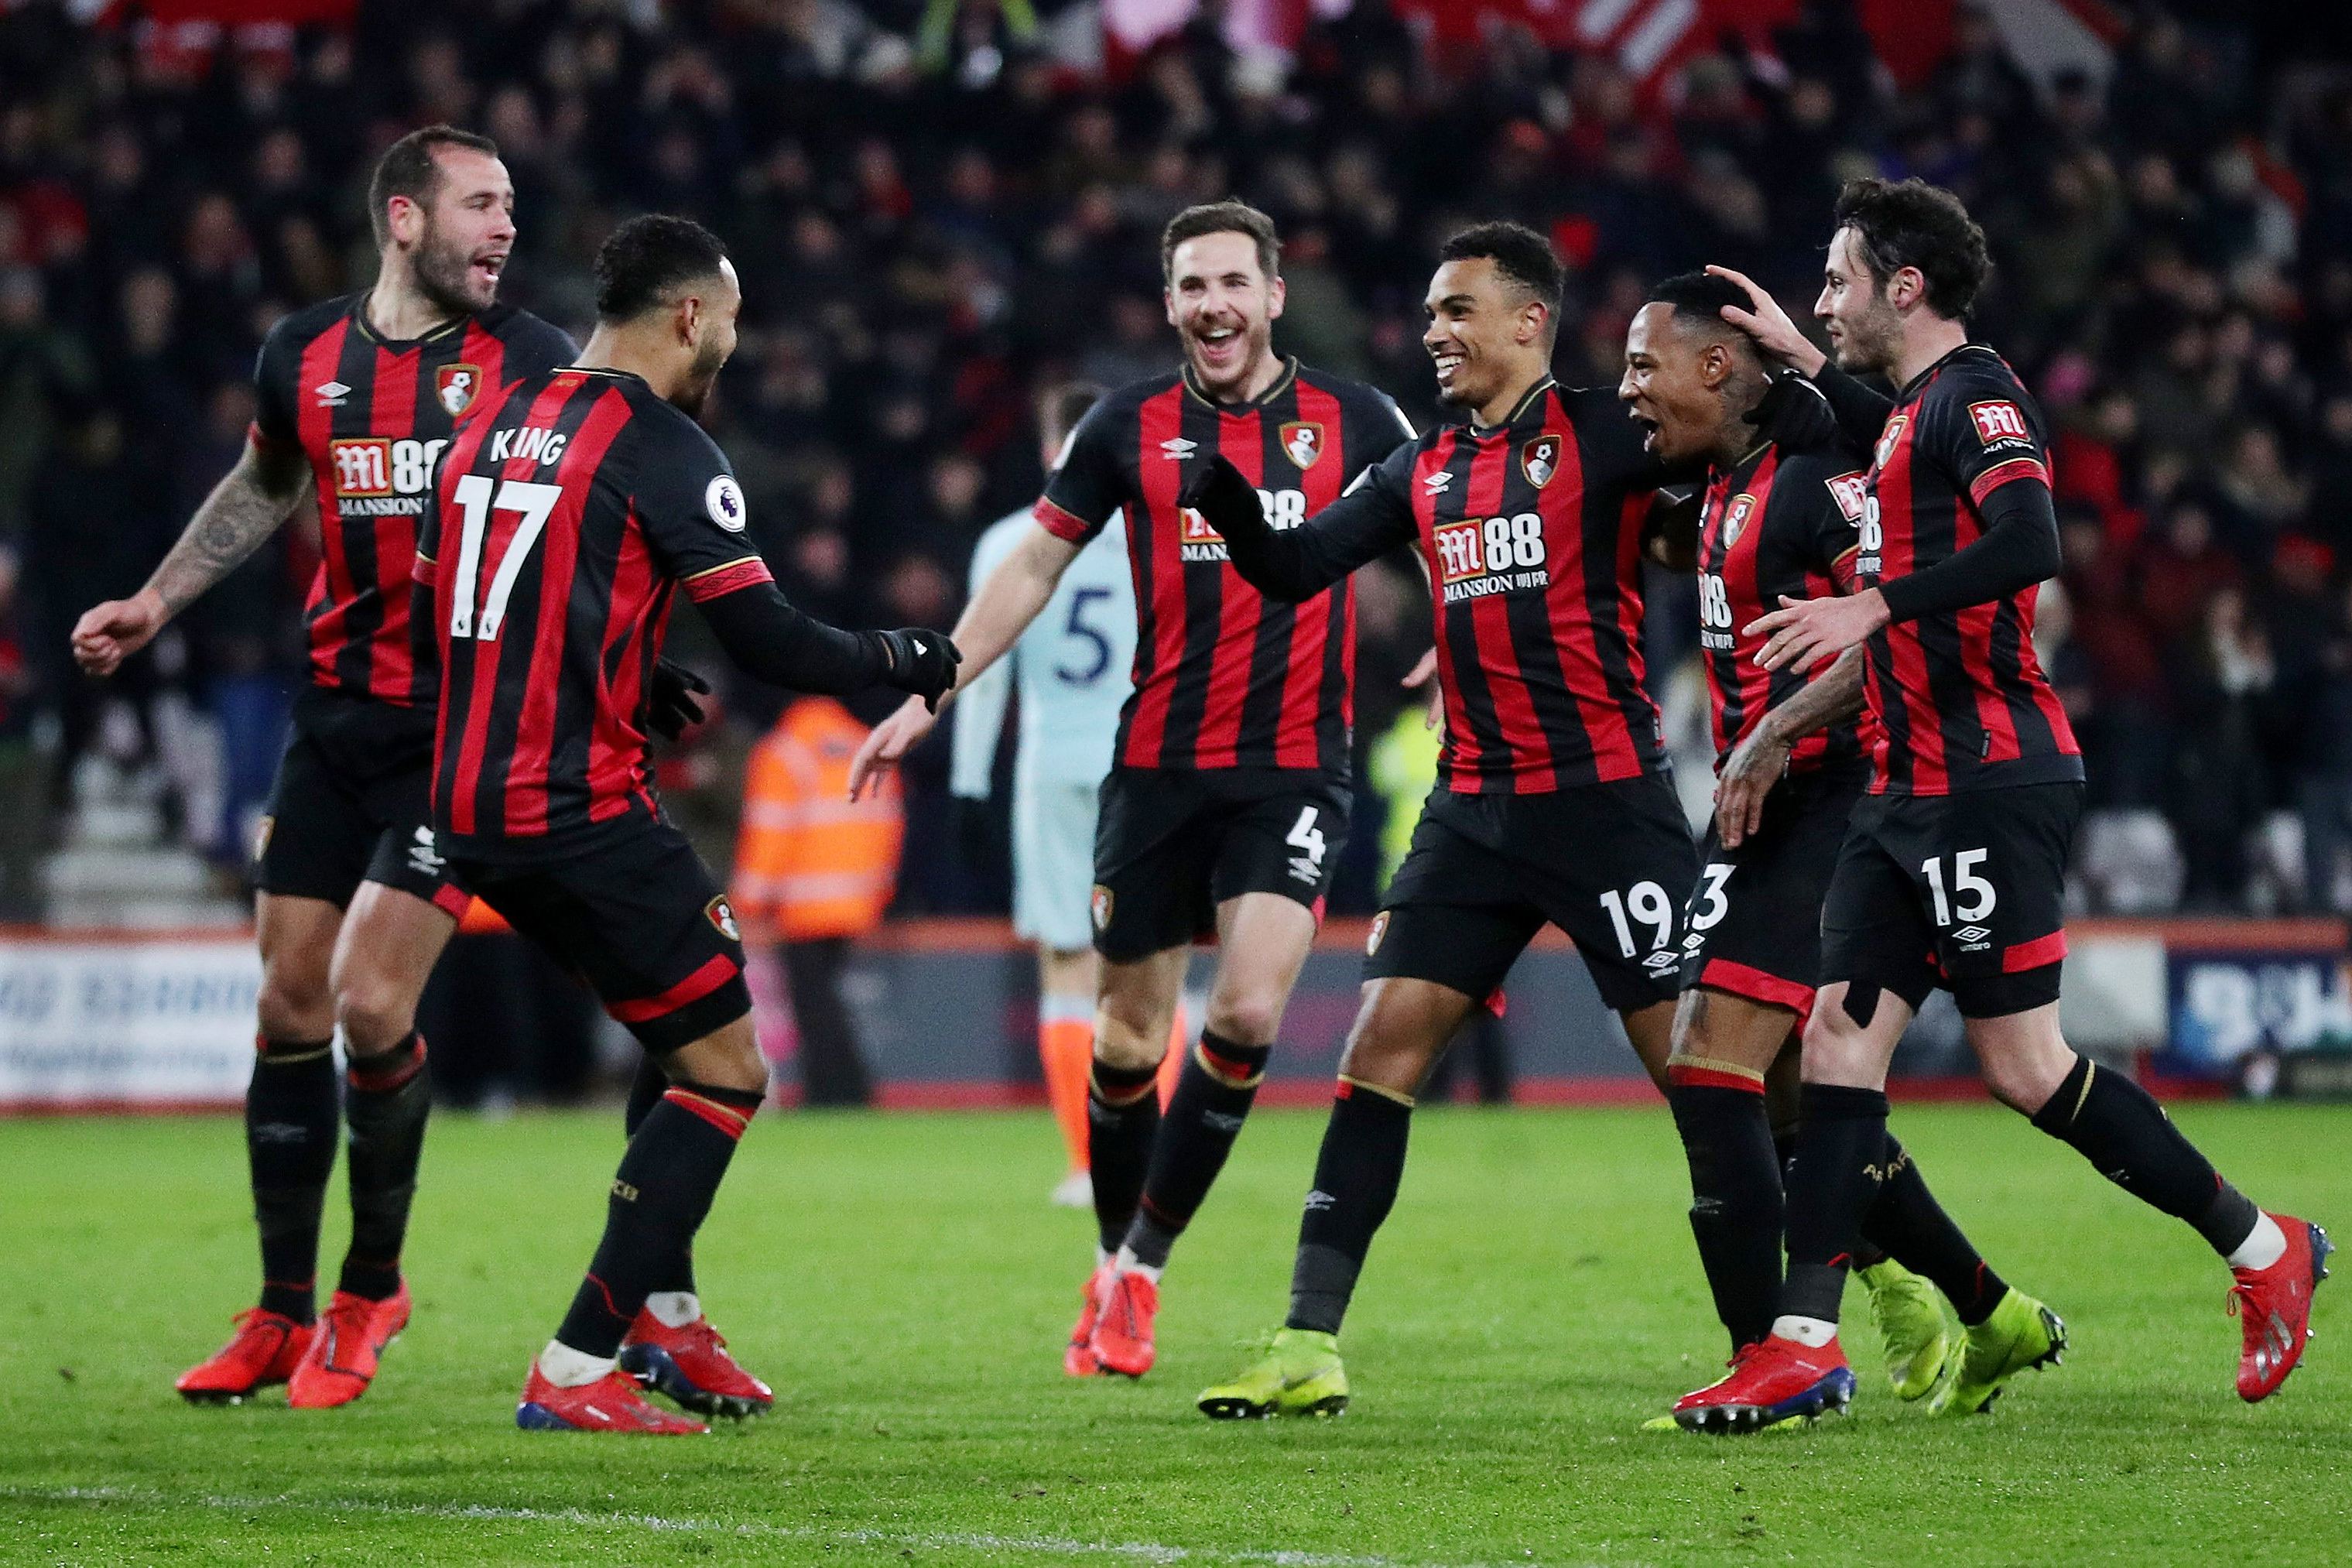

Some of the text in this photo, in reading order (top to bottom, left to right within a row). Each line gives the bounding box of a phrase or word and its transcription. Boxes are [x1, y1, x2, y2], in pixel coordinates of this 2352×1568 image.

[490, 426, 567, 466] KING
[450, 474, 563, 642] 17
[1443, 574, 1514, 603] MANSION
[1056, 587, 1112, 685] 5
[1286, 806, 1327, 864] 4
[1600, 880, 1672, 959] 19
[1683, 863, 1737, 931] 3
[1921, 847, 1997, 927] 15
